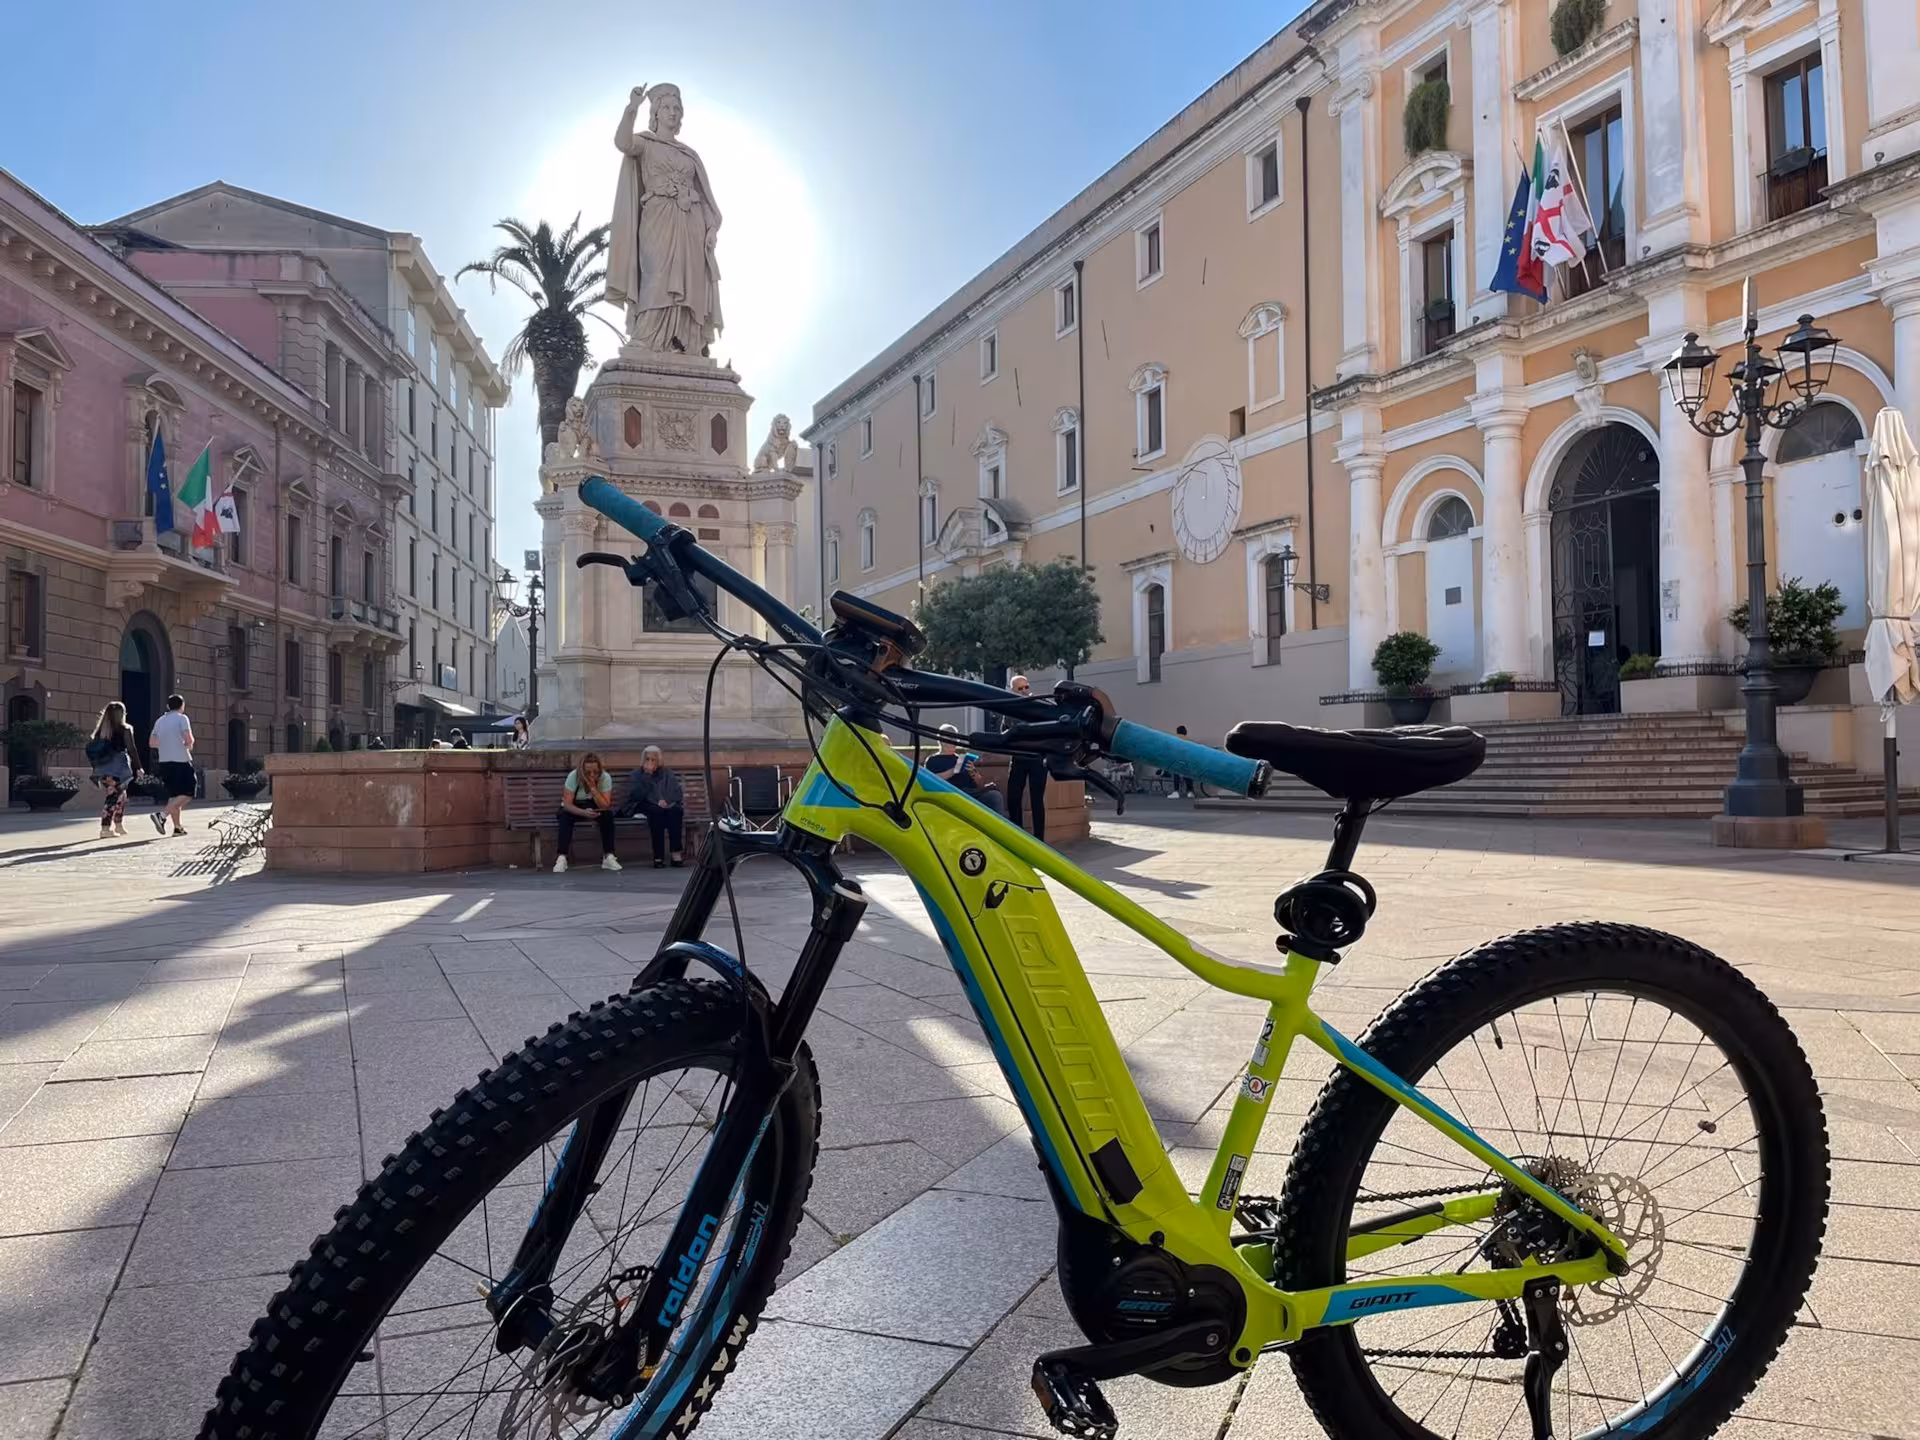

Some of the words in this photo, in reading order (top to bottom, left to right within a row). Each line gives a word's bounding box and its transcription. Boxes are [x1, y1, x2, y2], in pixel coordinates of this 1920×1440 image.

[657, 1213, 719, 1328] raidon
[1116, 1300, 1172, 1312] GIANT
[1349, 1291, 1419, 1310] GIANT
